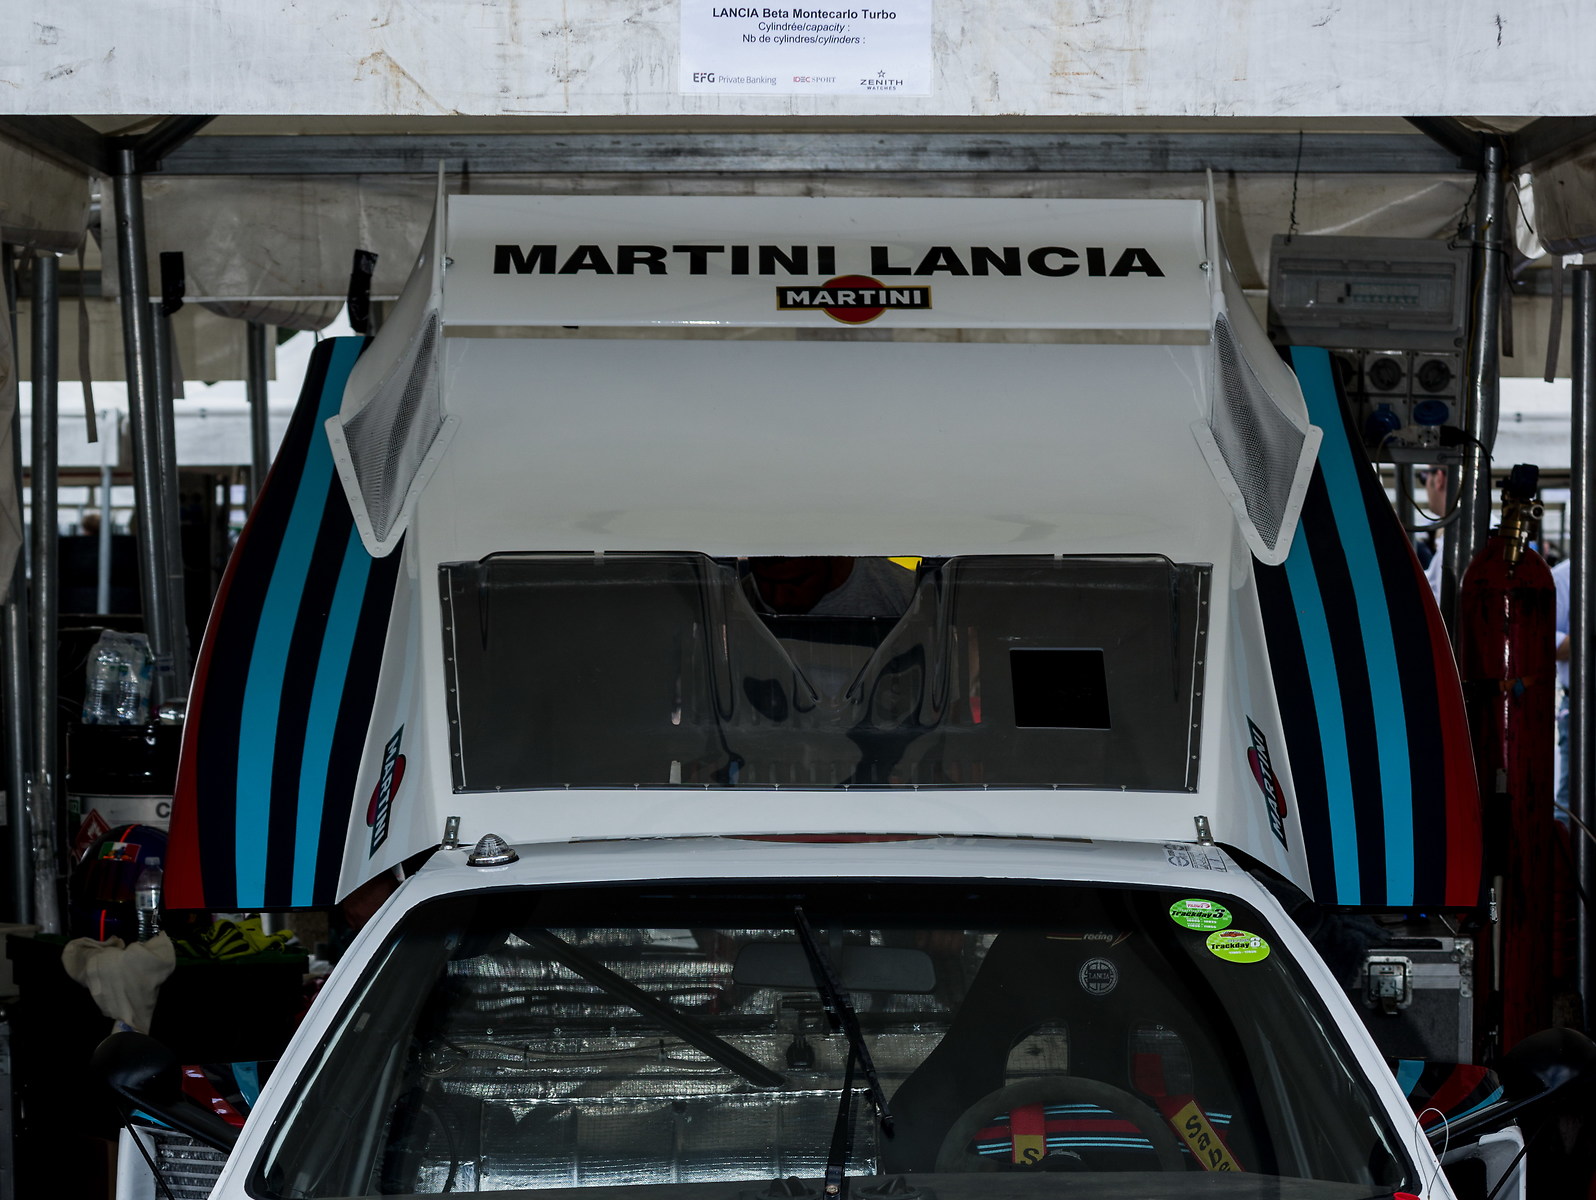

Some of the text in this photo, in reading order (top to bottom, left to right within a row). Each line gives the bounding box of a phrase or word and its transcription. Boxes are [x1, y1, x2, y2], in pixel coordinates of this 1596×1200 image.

[712, 8, 897, 20] LANCIA Beta Montecarlo Turbo
[758, 21, 846, 34] Cylindrée/capacity
[742, 34, 757, 43] Nb
[758, 34, 771, 43] de
[773, 34, 860, 46] cylindres/cylinders
[693, 72, 715, 83] EFG
[718, 75, 777, 85] Private Banking
[493, 244, 1165, 277] MARTINI LANCIA
[786, 289, 922, 306] MARTINI
[1252, 728, 1284, 839] MARTINI
[373, 735, 399, 847] MARTINI
[1171, 910, 1212, 919] Trackday
[1083, 931, 1113, 942] racing
[1211, 942, 1250, 950] Trackday
